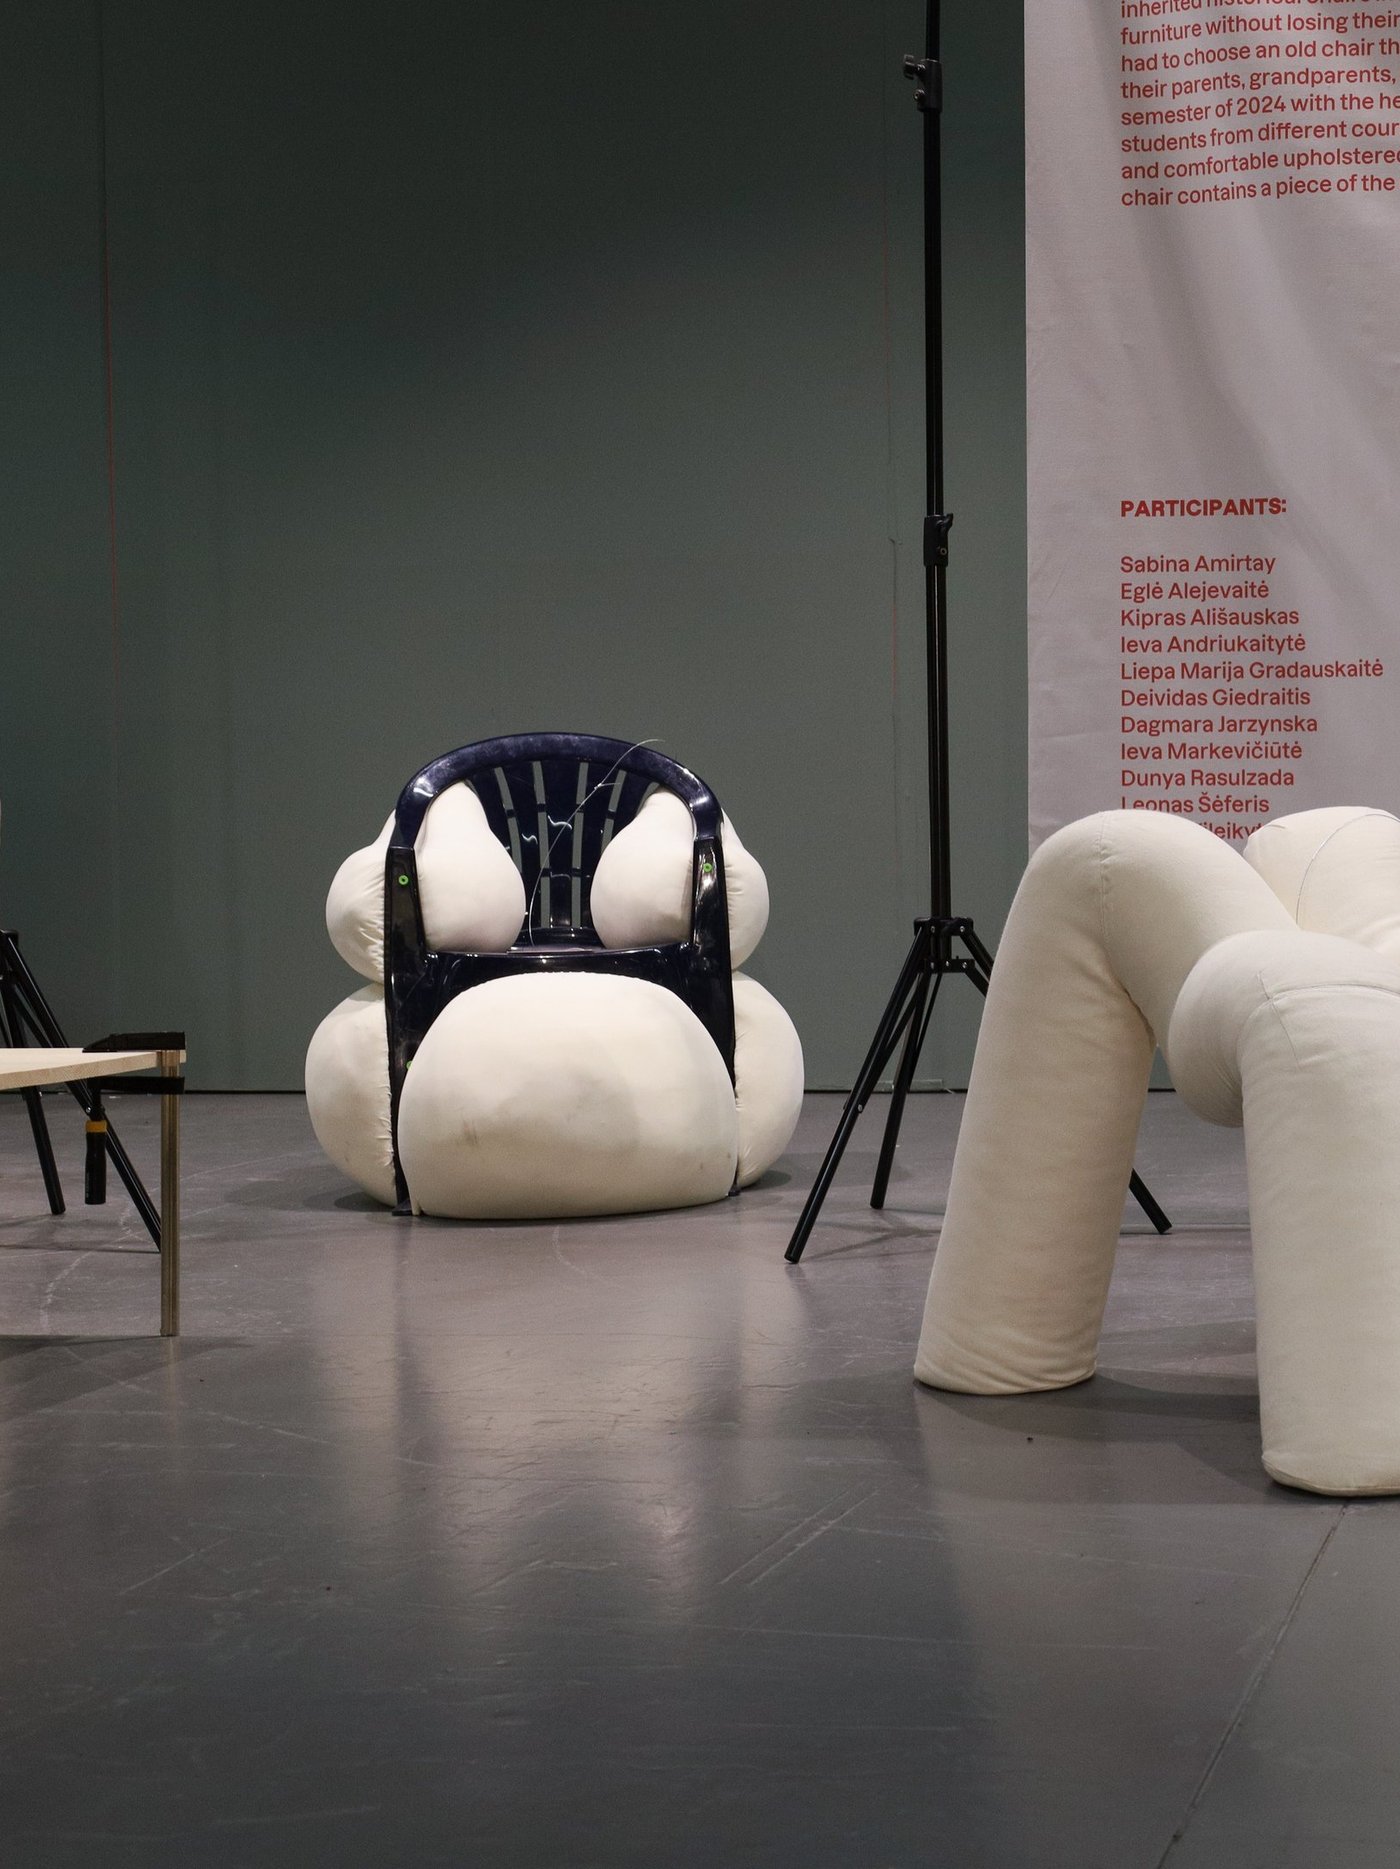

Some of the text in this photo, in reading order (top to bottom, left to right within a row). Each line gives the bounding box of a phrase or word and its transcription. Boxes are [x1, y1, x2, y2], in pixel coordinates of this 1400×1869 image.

[1120, 22, 1202, 46] furniture
[1204, 14, 1283, 36] without
[1287, 12, 1349, 34] losing
[1121, 52, 1158, 73] had
[1161, 52, 1181, 70] to
[1183, 45, 1251, 67] choose
[1255, 44, 1281, 59] an
[1284, 40, 1317, 58] old
[1321, 37, 1376, 58] chair
[1119, 79, 1168, 99] their
[1171, 71, 1246, 100] parents,
[1249, 65, 1397, 91] grandparents,
[1120, 104, 1212, 126] semester
[1214, 97, 1234, 118] of
[1236, 95, 1287, 116] 2024
[1290, 92, 1336, 112] with
[1339, 93, 1375, 111] the
[1121, 131, 1207, 153] students
[1209, 127, 1254, 147] from
[1257, 120, 1348, 142] different
[1120, 161, 1159, 180] and
[1163, 151, 1279, 179] comfortable
[1121, 187, 1174, 207] chair
[1177, 181, 1258, 205] contains
[1260, 182, 1272, 197] a
[1275, 175, 1332, 200] piece
[1336, 173, 1358, 193] of
[1360, 174, 1396, 192] the
[1120, 496, 1287, 518] PARTICIPANTS:
[1120, 553, 1277, 575] Sabina Amirtay
[1121, 579, 1270, 604] Eglė Alejevaitė
[1121, 605, 1300, 630] Kipras Ališauskas
[1121, 632, 1306, 656] Ieva Andriukaitytė
[1121, 658, 1384, 684] Liepa Marija Gradauskaitė
[1121, 686, 1311, 707] Deividas Giedraitis
[1121, 714, 1318, 737] Dagmara Jarzynska
[1121, 740, 1303, 761] Ieva Markevičiūtė
[1121, 768, 1295, 791] Dunya Rasulzada
[1197, 791, 1270, 814] Šėferis
